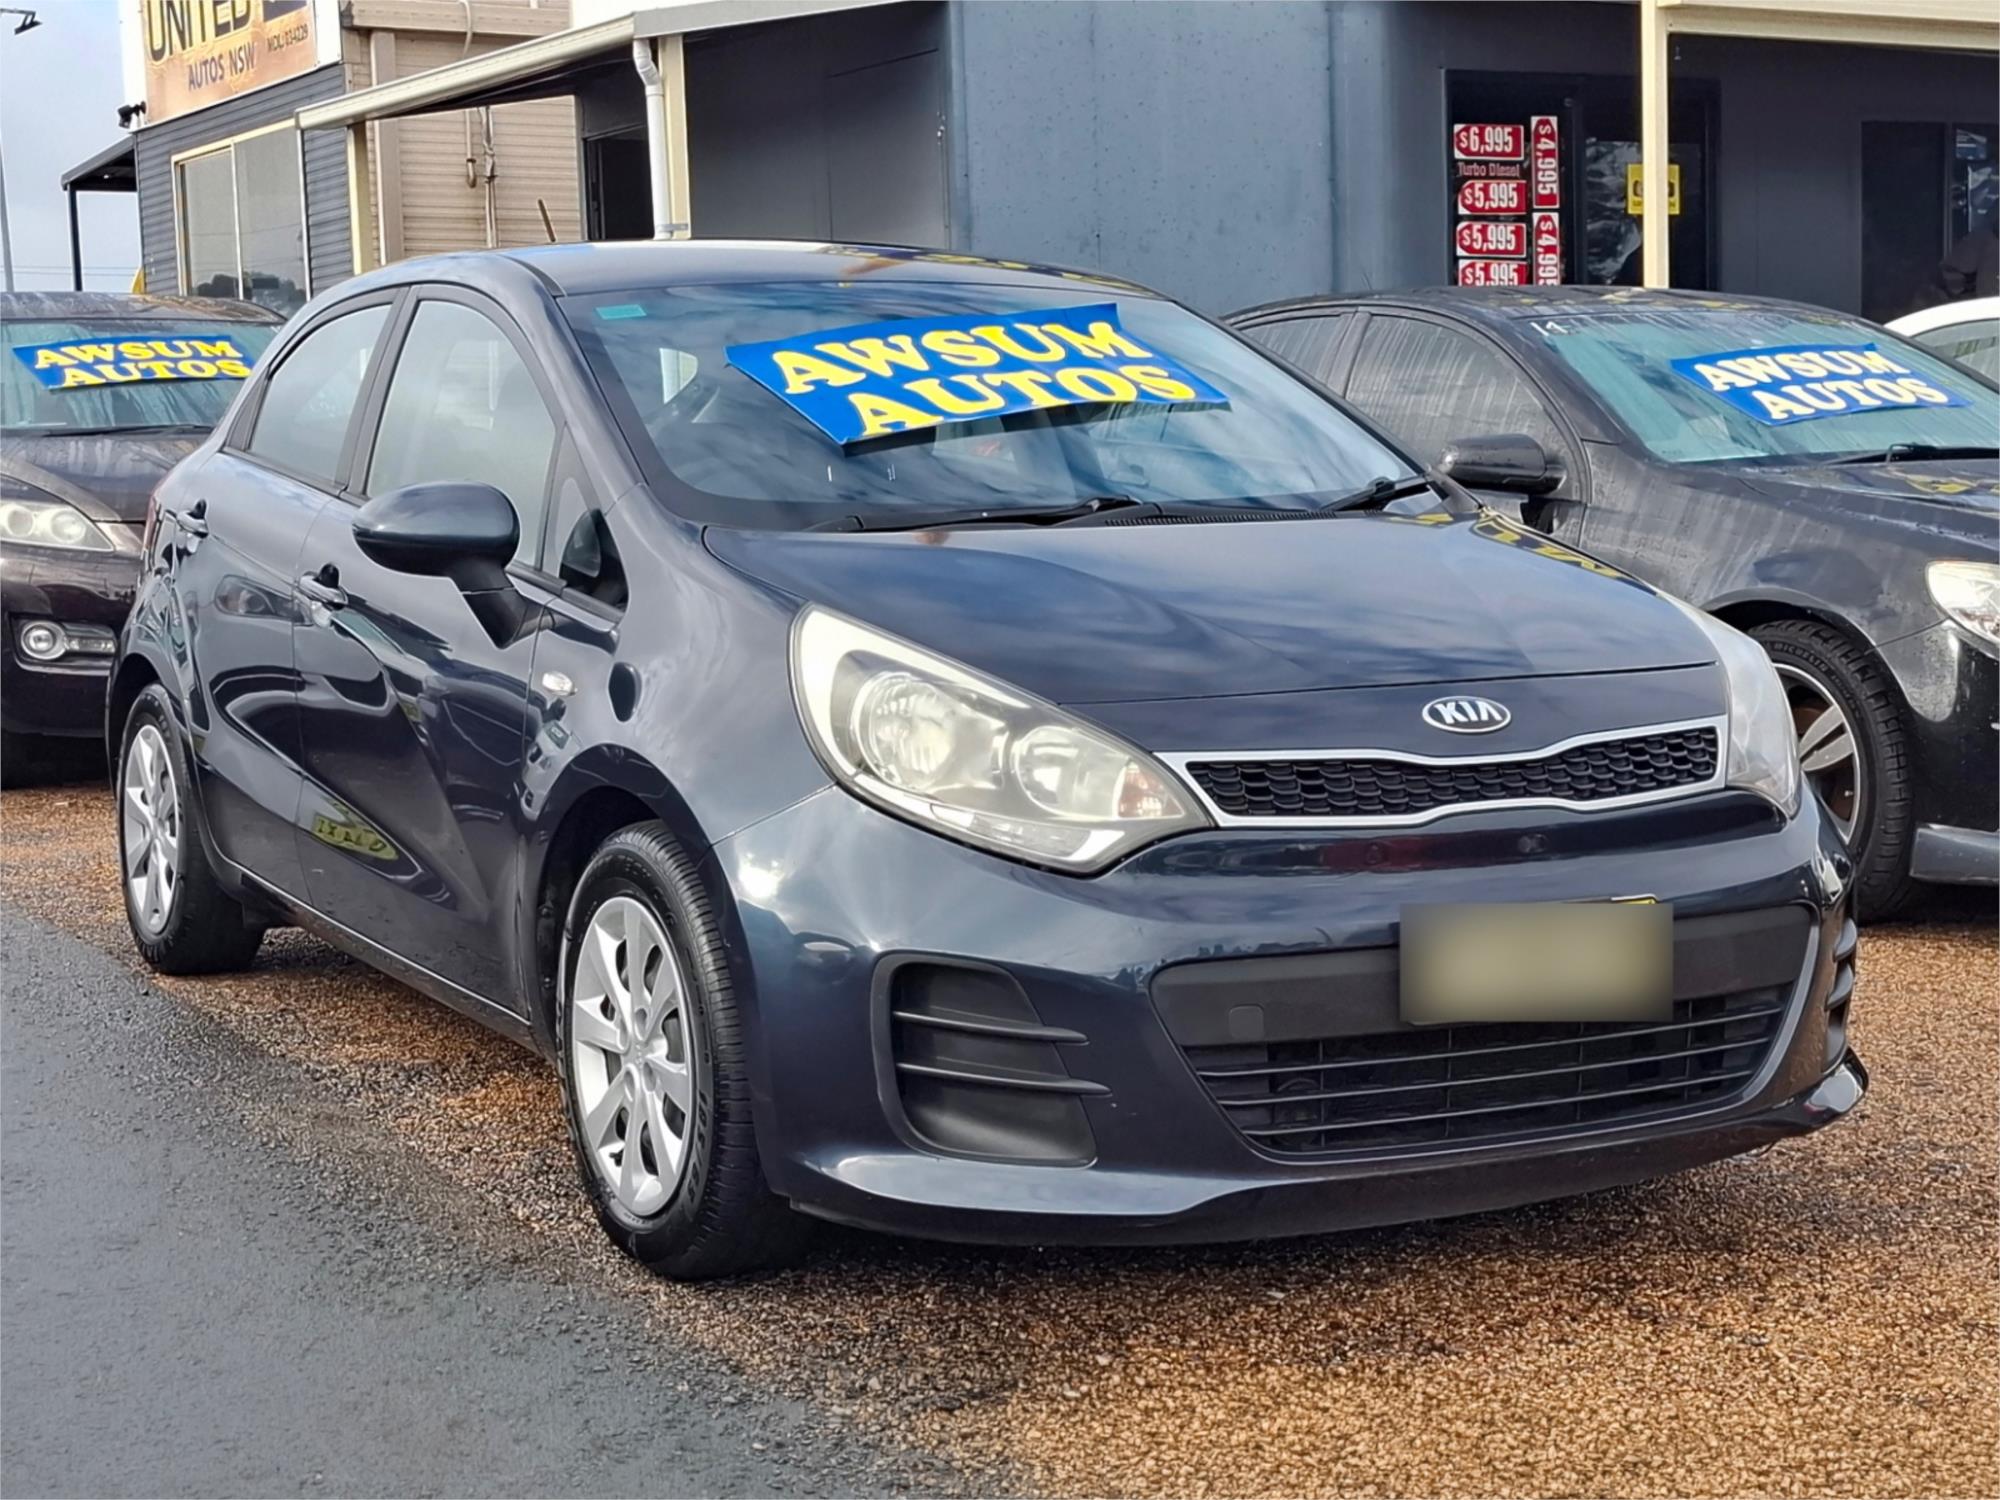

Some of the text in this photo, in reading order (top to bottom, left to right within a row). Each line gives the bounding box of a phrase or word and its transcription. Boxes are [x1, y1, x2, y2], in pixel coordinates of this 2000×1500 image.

[188, 42, 255, 92] AUTOS NSW
[1459, 126, 1512, 154] $6,995
[1456, 163, 1521, 177] Turbo Diesel
[1536, 124, 1558, 196] $4,995
[1464, 183, 1519, 209] $5,995
[1462, 225, 1516, 252] $5,995
[35, 340, 243, 369] AWSUM
[772, 321, 1153, 395] AWSUM
[62, 359, 251, 387] AUTOS
[1694, 349, 1912, 392] AWSUM
[848, 364, 1197, 436] AUTOS
[1751, 378, 1949, 421] AUTOS
[1433, 700, 1503, 724] KIA
